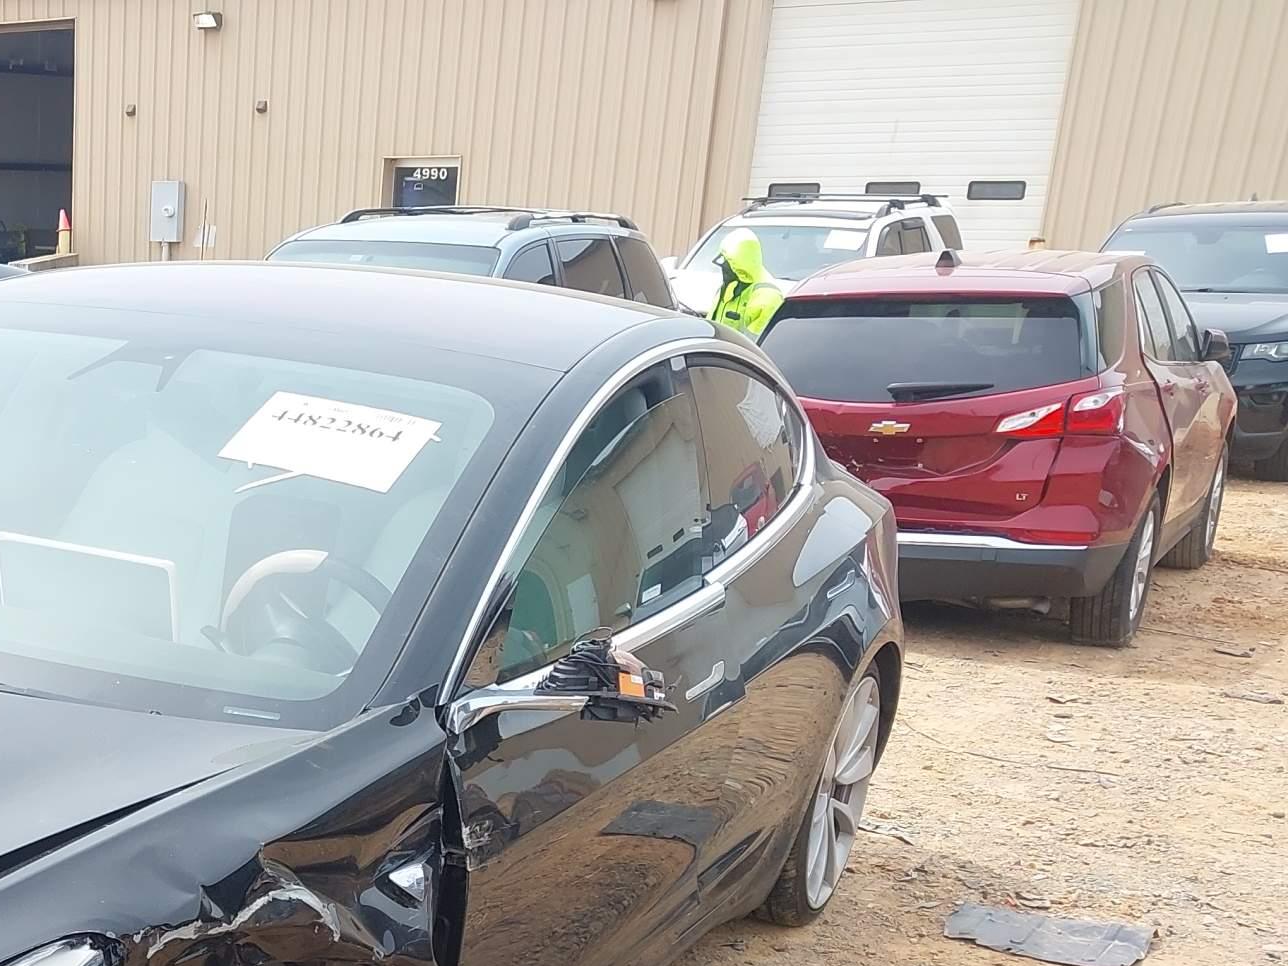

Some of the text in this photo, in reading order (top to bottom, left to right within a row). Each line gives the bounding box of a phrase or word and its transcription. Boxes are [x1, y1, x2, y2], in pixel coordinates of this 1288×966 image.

[413, 168, 448, 180] 4990
[272, 410, 403, 442] 44822864
[1015, 493, 1029, 501] LT
